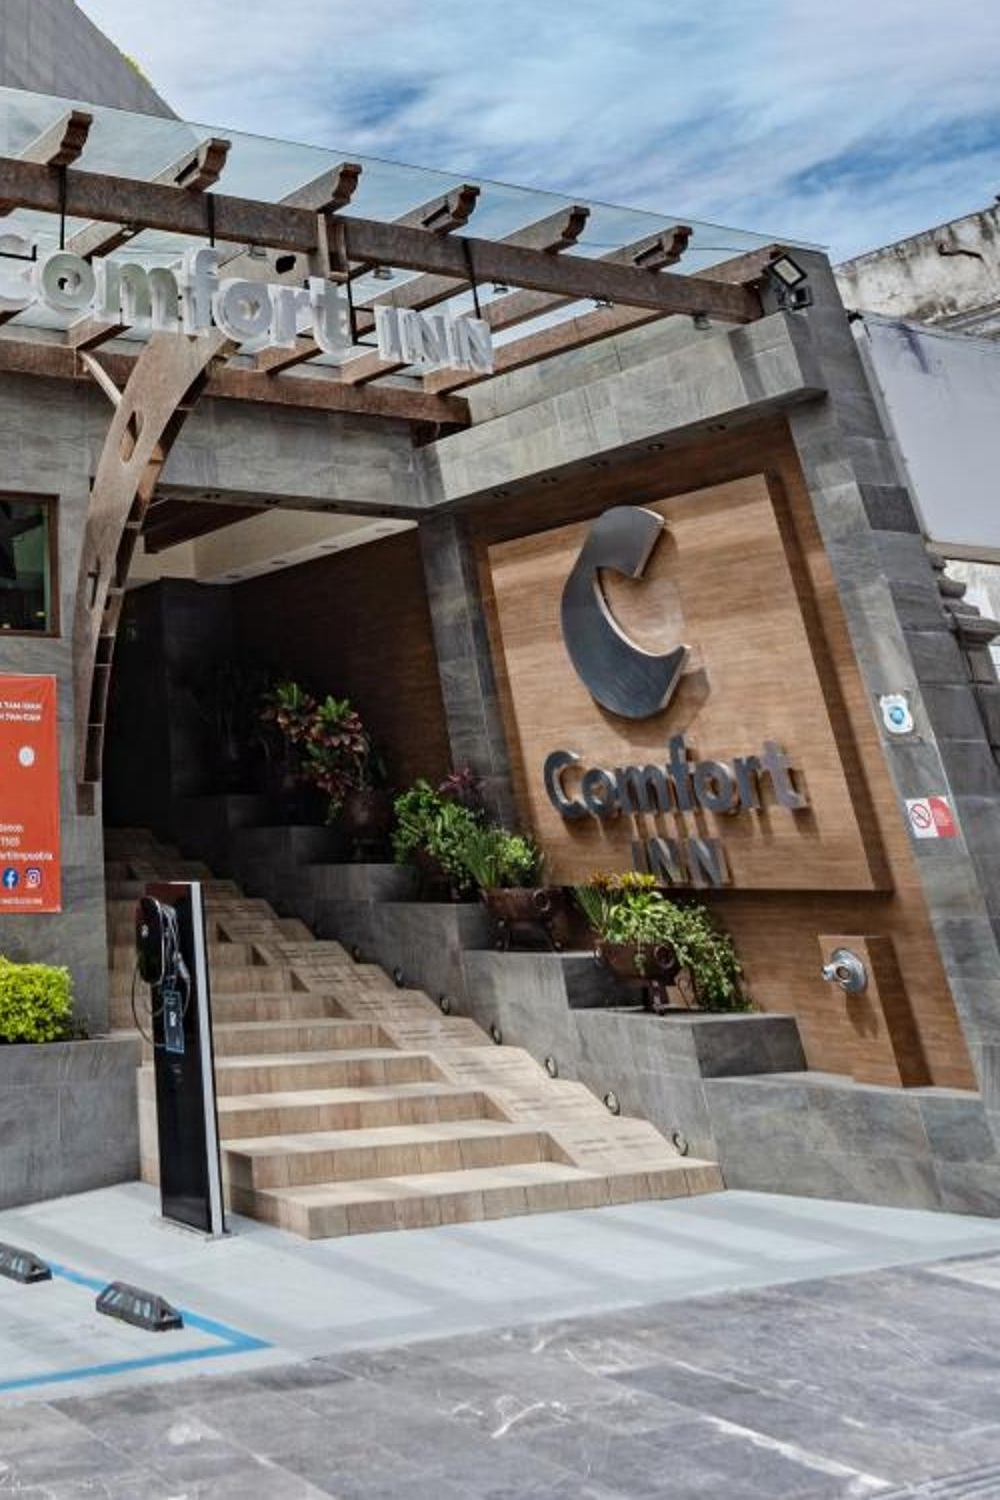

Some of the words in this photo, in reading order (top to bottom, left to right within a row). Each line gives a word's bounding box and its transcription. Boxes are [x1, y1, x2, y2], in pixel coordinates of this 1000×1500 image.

[374, 303, 493, 374] INN
[543, 733, 807, 820] Comfort
[631, 836, 726, 888] INN
